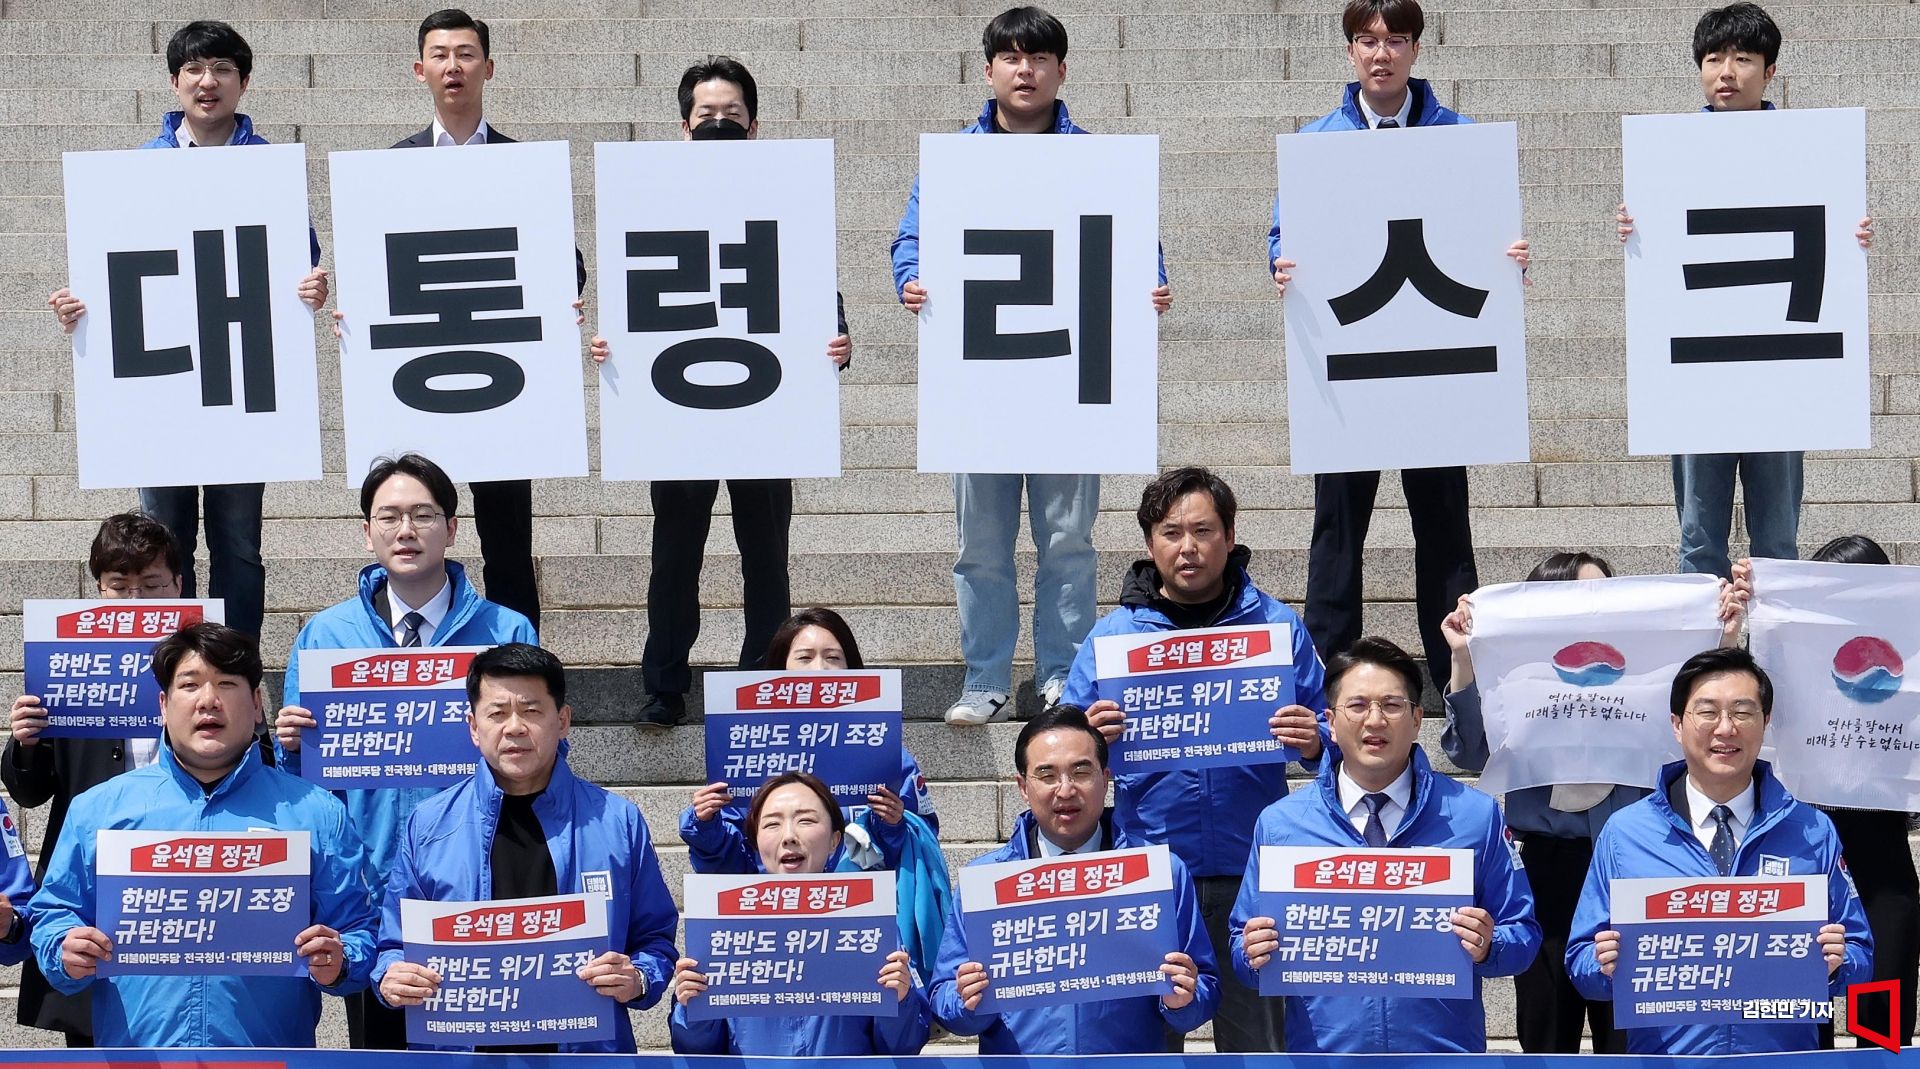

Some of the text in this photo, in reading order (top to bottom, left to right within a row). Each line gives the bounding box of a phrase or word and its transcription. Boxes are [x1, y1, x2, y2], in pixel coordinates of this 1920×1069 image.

[1670, 205, 1844, 365] 크
[962, 215, 1113, 405] 리
[1327, 218, 1497, 382] 스
[107, 225, 276, 413] 대
[370, 227, 542, 414] 통
[626, 220, 782, 410] 령
[76, 611, 180, 634] 윤석열 정권
[49, 652, 112, 678] 한반도
[1147, 637, 1248, 667] 윤석열 정권
[351, 658, 455, 683] 윤석열 정권
[43, 683, 138, 707] 규탄한다!
[755, 681, 858, 705] 윤석열 정권
[1123, 676, 1281, 712] 한반도 위기 조장
[48, 715, 105, 727] 더불어민주당
[324, 702, 387, 727] 한반도
[394, 700, 436, 726] 위기
[1525, 704, 1560, 719] 미래를
[1601, 706, 1647, 721] 없습니다
[729, 722, 888, 749] 한반도 위기 조장
[1122, 712, 1211, 742] 규탄한다!
[1828, 718, 1903, 734] 역사를 팔아서
[319, 731, 413, 757] 규탄한다!
[1806, 733, 1837, 748] 미래를
[723, 752, 816, 778] 규탄한다!
[1123, 748, 1181, 762] 더불어민주당
[322, 763, 478, 778] 더불어민주당 전국청년·대학생위원
[151, 844, 263, 868] 윤석열 정권
[1015, 862, 1124, 898] 윤석열 정권
[1315, 861, 1426, 886] 윤석열 정권
[121, 887, 295, 913] 한반도 위기 조장
[738, 885, 849, 911] 윤석열 정권
[1667, 889, 1780, 914] 윤석열 정권
[452, 908, 562, 938] 윤석열 정권
[991, 903, 1161, 947] 한반도 위기 조장
[1285, 903, 1457, 933] 한반도 위기 조장
[115, 918, 216, 945] 규탄한다!
[710, 927, 882, 956] 한반도 위기 조장
[118, 952, 180, 964] 더불어민주당
[1279, 936, 1379, 962] 규탄한다!
[1637, 933, 1813, 961] 한반도 위기 조장
[426, 956, 492, 981] 한반도
[499, 953, 545, 981] 위기
[705, 959, 805, 986] 규탄한다!
[989, 943, 1087, 979] 규탄한다!
[1282, 971, 1344, 984] 더불어민주당
[1631, 964, 1733, 993] 규탄한다!
[708, 993, 771, 1006] 더불어민주당
[995, 983, 1056, 1000] 더불어민주당
[1635, 1001, 1697, 1015] 더불어민주당
[426, 1020, 487, 1033] 더불어민주당
